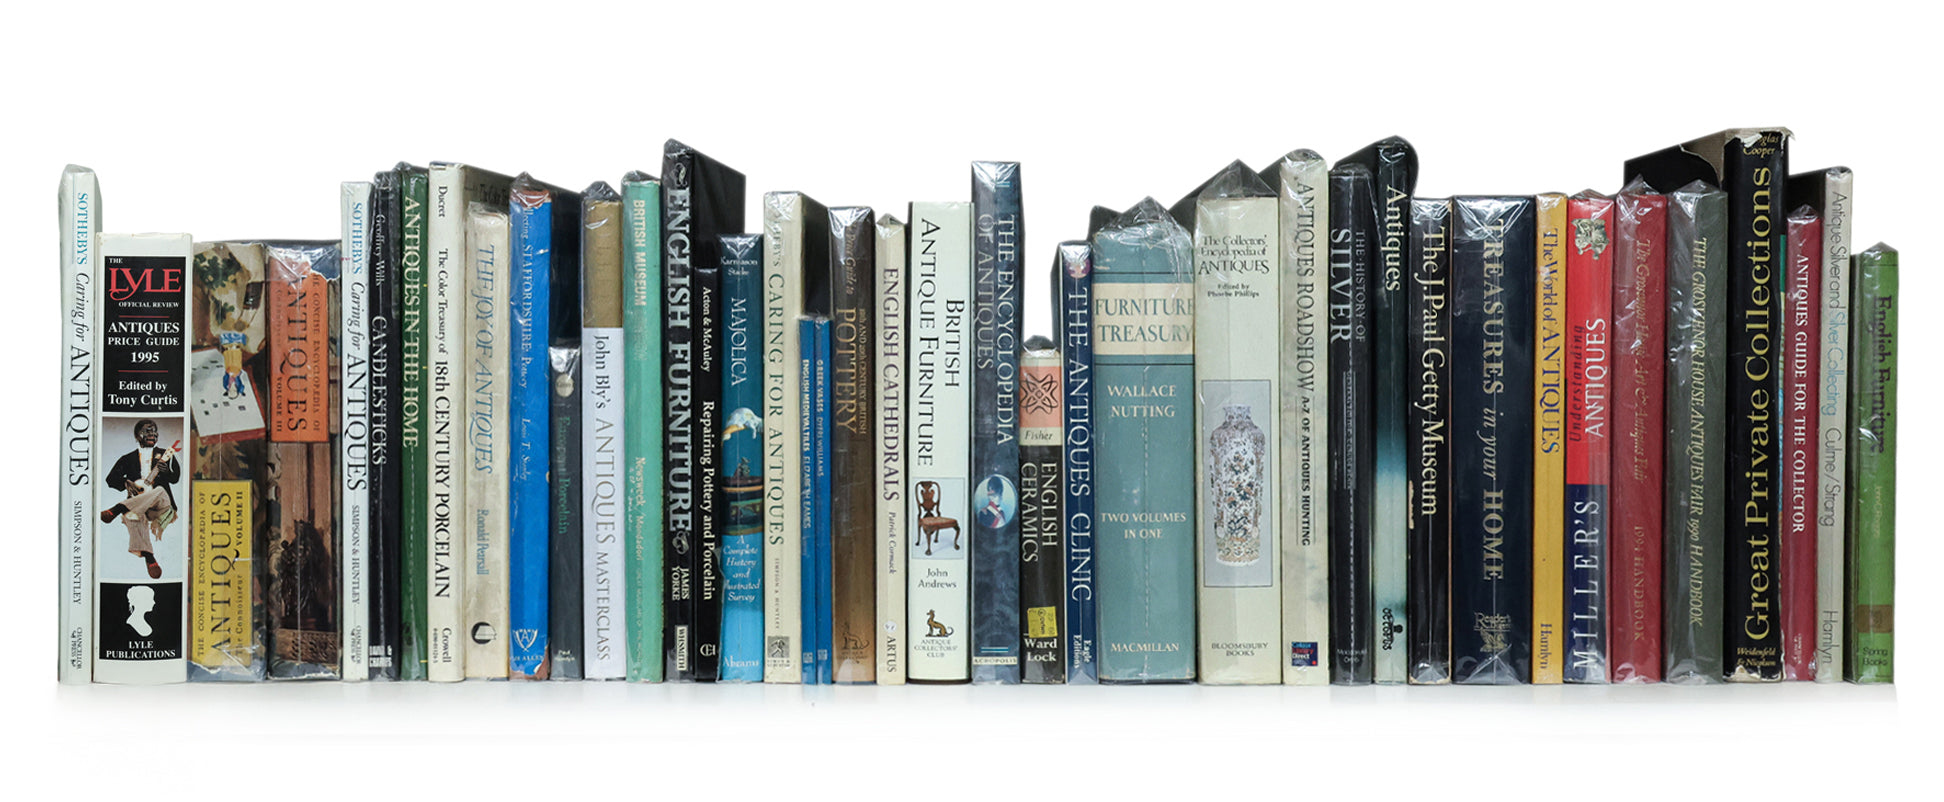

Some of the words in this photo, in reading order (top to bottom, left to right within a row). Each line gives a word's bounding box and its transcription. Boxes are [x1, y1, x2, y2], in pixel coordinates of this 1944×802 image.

[438, 186, 448, 217] Ducret
[634, 200, 646, 247] BRITISH
[1826, 191, 1848, 244] Antique
[401, 196, 421, 306] ANTIQUES
[979, 213, 995, 243] OF
[997, 215, 1014, 262] THE
[1204, 236, 1220, 245] The
[1295, 182, 1315, 277] ANTIQUES
[1380, 185, 1407, 292] Antiques
[1423, 226, 1445, 272] The
[1542, 227, 1558, 260] The
[439, 249, 448, 268] The
[476, 245, 495, 290] THE
[667, 186, 690, 328] ENGLISH
[918, 218, 940, 328] ANTIQUE
[1198, 259, 1269, 275] ANTIQUES
[1693, 238, 1707, 268] THE
[1746, 168, 1770, 381] Collections
[71, 273, 89, 318] Caring
[109, 268, 181, 300] LYLE
[438, 270, 448, 297] Color
[633, 252, 647, 305] MUSEUM
[703, 287, 711, 315] Acton
[1218, 283, 1240, 291] Edited
[1331, 228, 1353, 345] SILVER
[1541, 260, 1558, 306] World
[1793, 254, 1808, 326] ANTIQUES
[347, 282, 365, 327] Caring
[405, 310, 419, 333] IN
[435, 300, 448, 341] Treasury
[471, 293, 493, 329] JOY
[703, 317, 711, 325] &
[769, 274, 784, 362] CARING
[883, 268, 898, 357] ENGLISH
[974, 250, 995, 369] ANTIQUES
[1069, 286, 1088, 347] THE
[1095, 299, 1193, 316] FURNITURE
[1482, 218, 1505, 393] TREASURES
[71, 319, 89, 341] for
[108, 337, 140, 345] PRICE
[109, 322, 179, 335] ANTIQUES
[348, 328, 365, 350] for
[439, 344, 448, 354] of
[476, 330, 494, 358] OF
[701, 328, 712, 371] McAuley
[729, 298, 746, 386] MAJOLICA
[945, 300, 964, 386] BRITISH
[1097, 325, 1193, 342] TREASURY
[1296, 283, 1315, 391] ROADSHOW
[1866, 294, 1892, 364] English
[132, 352, 159, 362] 1995
[404, 338, 419, 381] THE
[594, 336, 610, 369] John
[837, 308, 857, 433] POTTERY
[997, 270, 1013, 444] ENCYCLOPEDIA
[1795, 332, 1807, 377] GUIDE
[119, 381, 152, 390] Edited
[155, 382, 166, 392] by
[373, 316, 387, 464] CANDLESTICKS
[435, 361, 449, 391] 18th
[769, 374, 784, 416] FOR
[1108, 385, 1175, 397] WALLACE
[1414, 348, 1445, 414] Getty
[1540, 327, 1560, 453] ANTIQUES
[1585, 318, 1607, 437] ANTIQUES
[1691, 360, 1705, 406] HOUSE
[1795, 384, 1806, 411] FOR
[1820, 347, 1846, 416] Collecting
[66, 346, 90, 485] ANTIQUES
[108, 394, 136, 407] Tony
[141, 395, 177, 405] Curtis
[345, 354, 368, 493] ANTIQUES
[403, 387, 418, 447] HOME
[470, 360, 492, 474] ANTIQUES
[918, 337, 939, 465] FURNITURE
[1112, 405, 1174, 417] NUTTING
[1301, 396, 1310, 413] A-Z
[1483, 407, 1503, 427] in
[435, 396, 450, 487] CENTURY
[669, 341, 692, 532] FURNITURE
[700, 402, 714, 465] Repairing
[884, 364, 899, 500] CATHEDRALS
[1023, 431, 1053, 440] Fisher
[1068, 358, 1090, 496] ANTIQUES
[1302, 418, 1310, 432] OF
[1686, 406, 1704, 481] ANTIQUES
[1794, 416, 1805, 444] THE
[1302, 435, 1310, 491] ANTIQUES
[1422, 419, 1443, 515] Museum
[1477, 433, 1496, 481] your
[1745, 389, 1768, 526] Private
[591, 418, 615, 543] ANTIQUES
[700, 468, 714, 512] Pottery
[767, 428, 784, 545] ANTIQUES
[1690, 484, 1703, 515] FAIR
[1793, 450, 1805, 532] COLLECTOR
[74, 501, 82, 542] SIMPSON
[704, 515, 715, 538] and
[1022, 462, 1038, 562] CERAMICS
[1041, 463, 1057, 545] ENGLISH
[1102, 513, 1129, 523] TWO
[1132, 513, 1186, 522] VOLUMES
[1302, 495, 1310, 545] HUNTING
[435, 493, 449, 597] PORCELAIN
[1125, 530, 1136, 538] IN
[1139, 529, 1161, 538] ONE
[1483, 489, 1503, 580] HOME
[1688, 518, 1699, 541] 1990
[211, 492, 240, 651] ANTIQUES
[704, 542, 715, 599] Porcelain
[927, 568, 948, 577] John
[1071, 513, 1091, 600] CLINIC
[73, 557, 81, 604] HUNTLEY
[352, 559, 360, 604] HUNTLEY
[672, 566, 681, 600] YORKE
[681, 568, 689, 599] JAMES
[918, 579, 956, 588] Andrews
[1573, 501, 1600, 670] MILLER'S
[1634, 557, 1644, 641] HANDBOOK
[1689, 544, 1703, 626] HANDBOOK
[1745, 535, 1769, 639] Great
[596, 552, 610, 660] MASTERCLASS
[106, 650, 176, 659] PUBLICATIONS
[442, 628, 452, 662] Crowell
[887, 636, 896, 672] ARTUS
[1025, 638, 1057, 648] Ward
[1027, 652, 1056, 661] Lock
[1073, 634, 1083, 669] Editions
[1082, 640, 1091, 663] Eagle
[1112, 643, 1179, 652] MACMILLAN
[1538, 623, 1553, 670] Hamlyn
[1818, 610, 1839, 664] Hamlyn
[1863, 657, 1888, 666] Books
